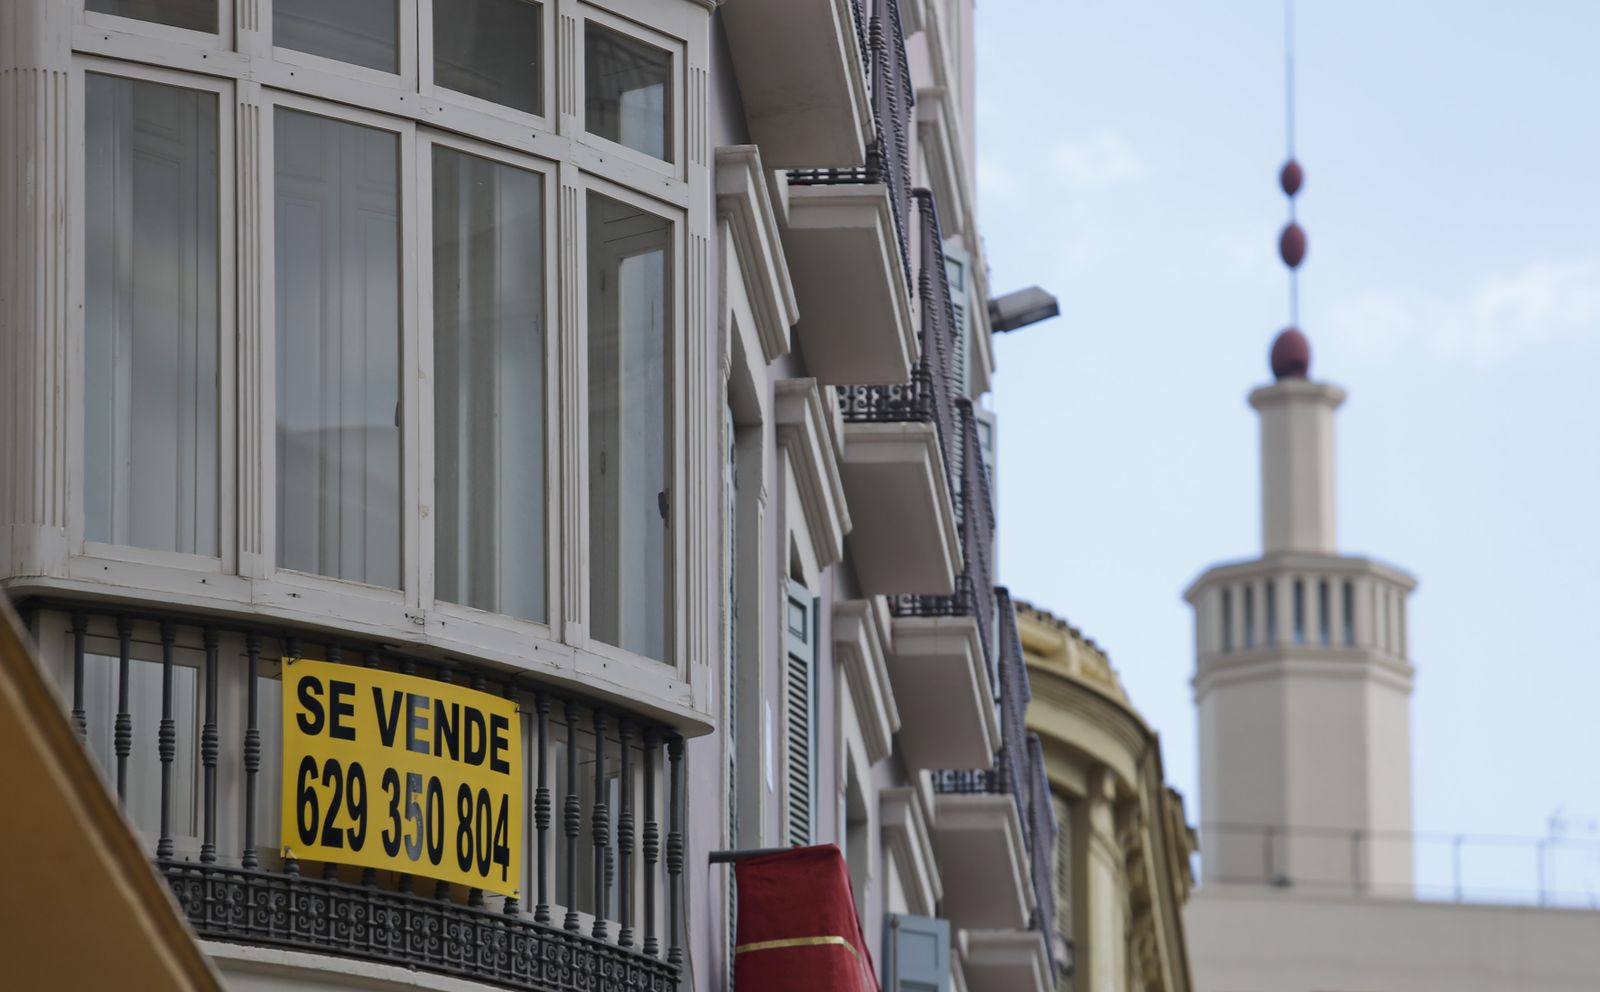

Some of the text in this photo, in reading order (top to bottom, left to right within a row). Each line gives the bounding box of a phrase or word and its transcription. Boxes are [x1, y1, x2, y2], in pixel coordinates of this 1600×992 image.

[296, 675, 510, 775] SE VENDE
[296, 755, 510, 882] 629 350 804
